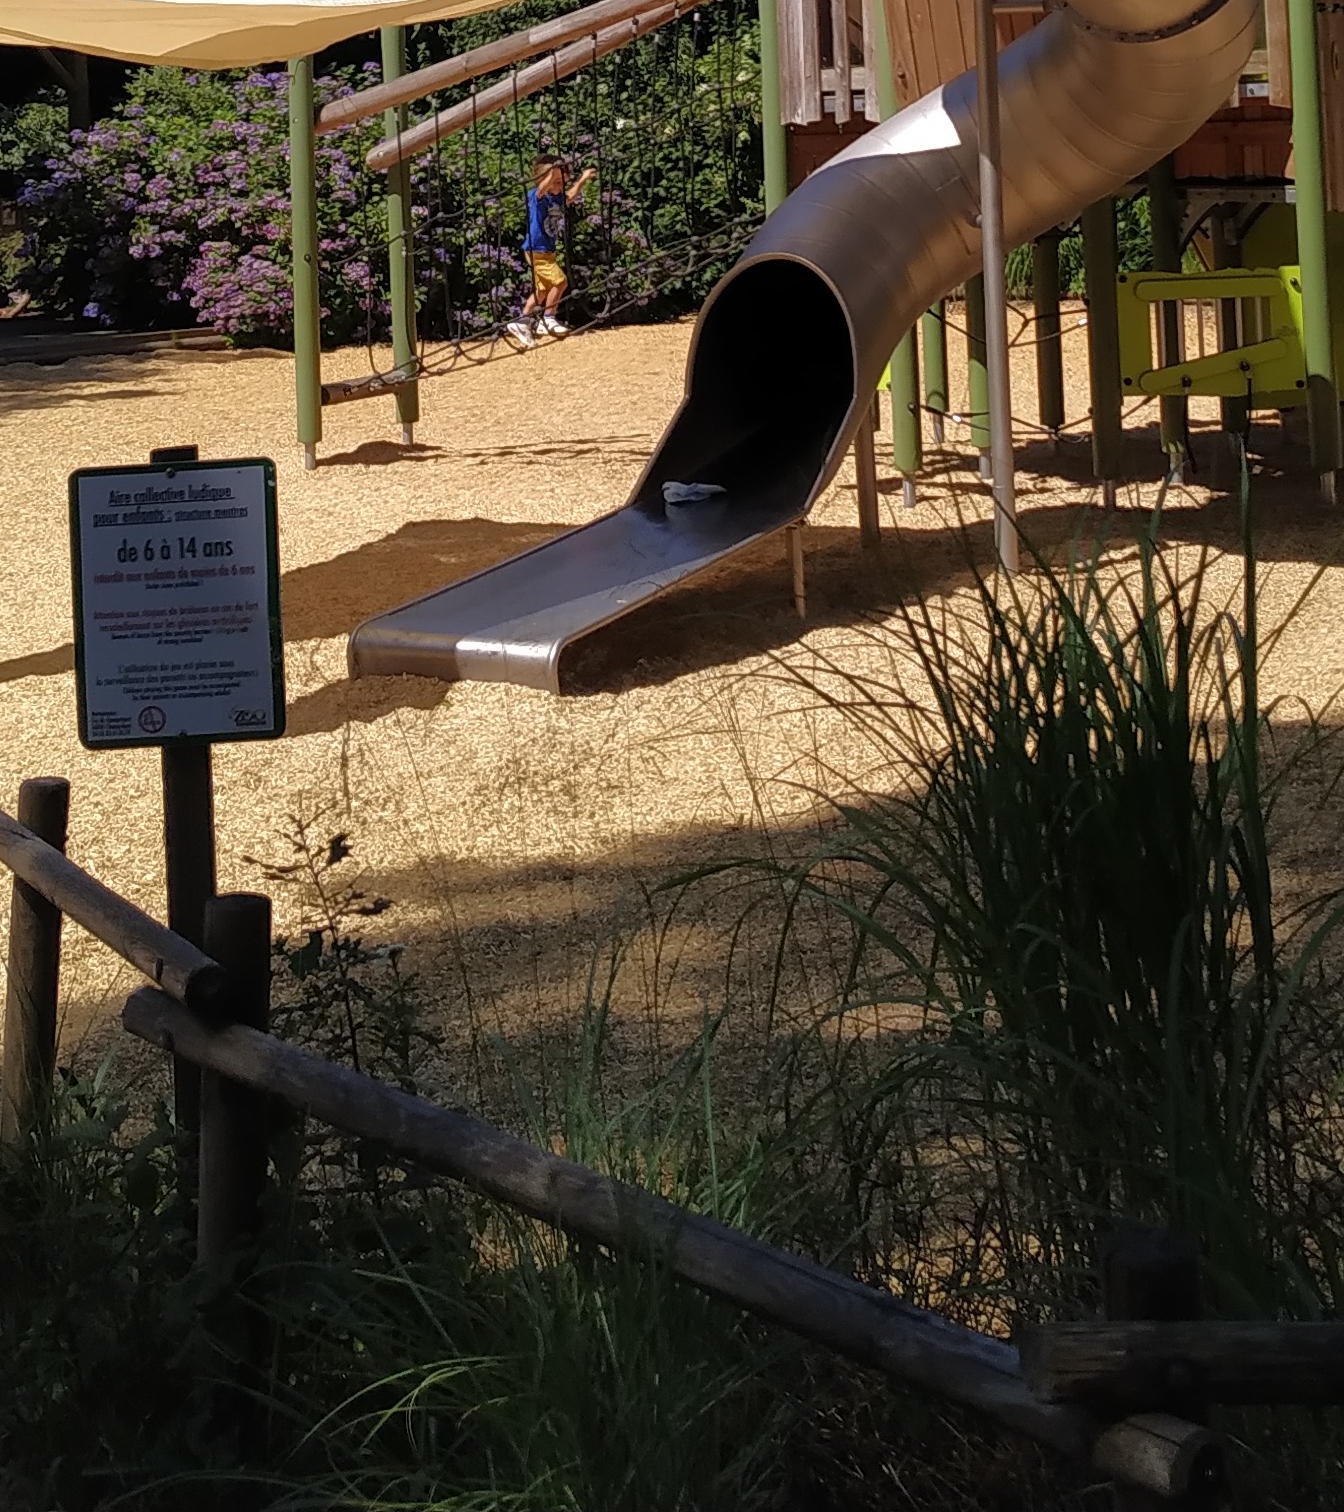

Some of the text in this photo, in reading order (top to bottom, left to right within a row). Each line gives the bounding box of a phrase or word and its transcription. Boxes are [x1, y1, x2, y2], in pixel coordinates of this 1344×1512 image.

[117, 536, 234, 563] de 6 à 14 ans
